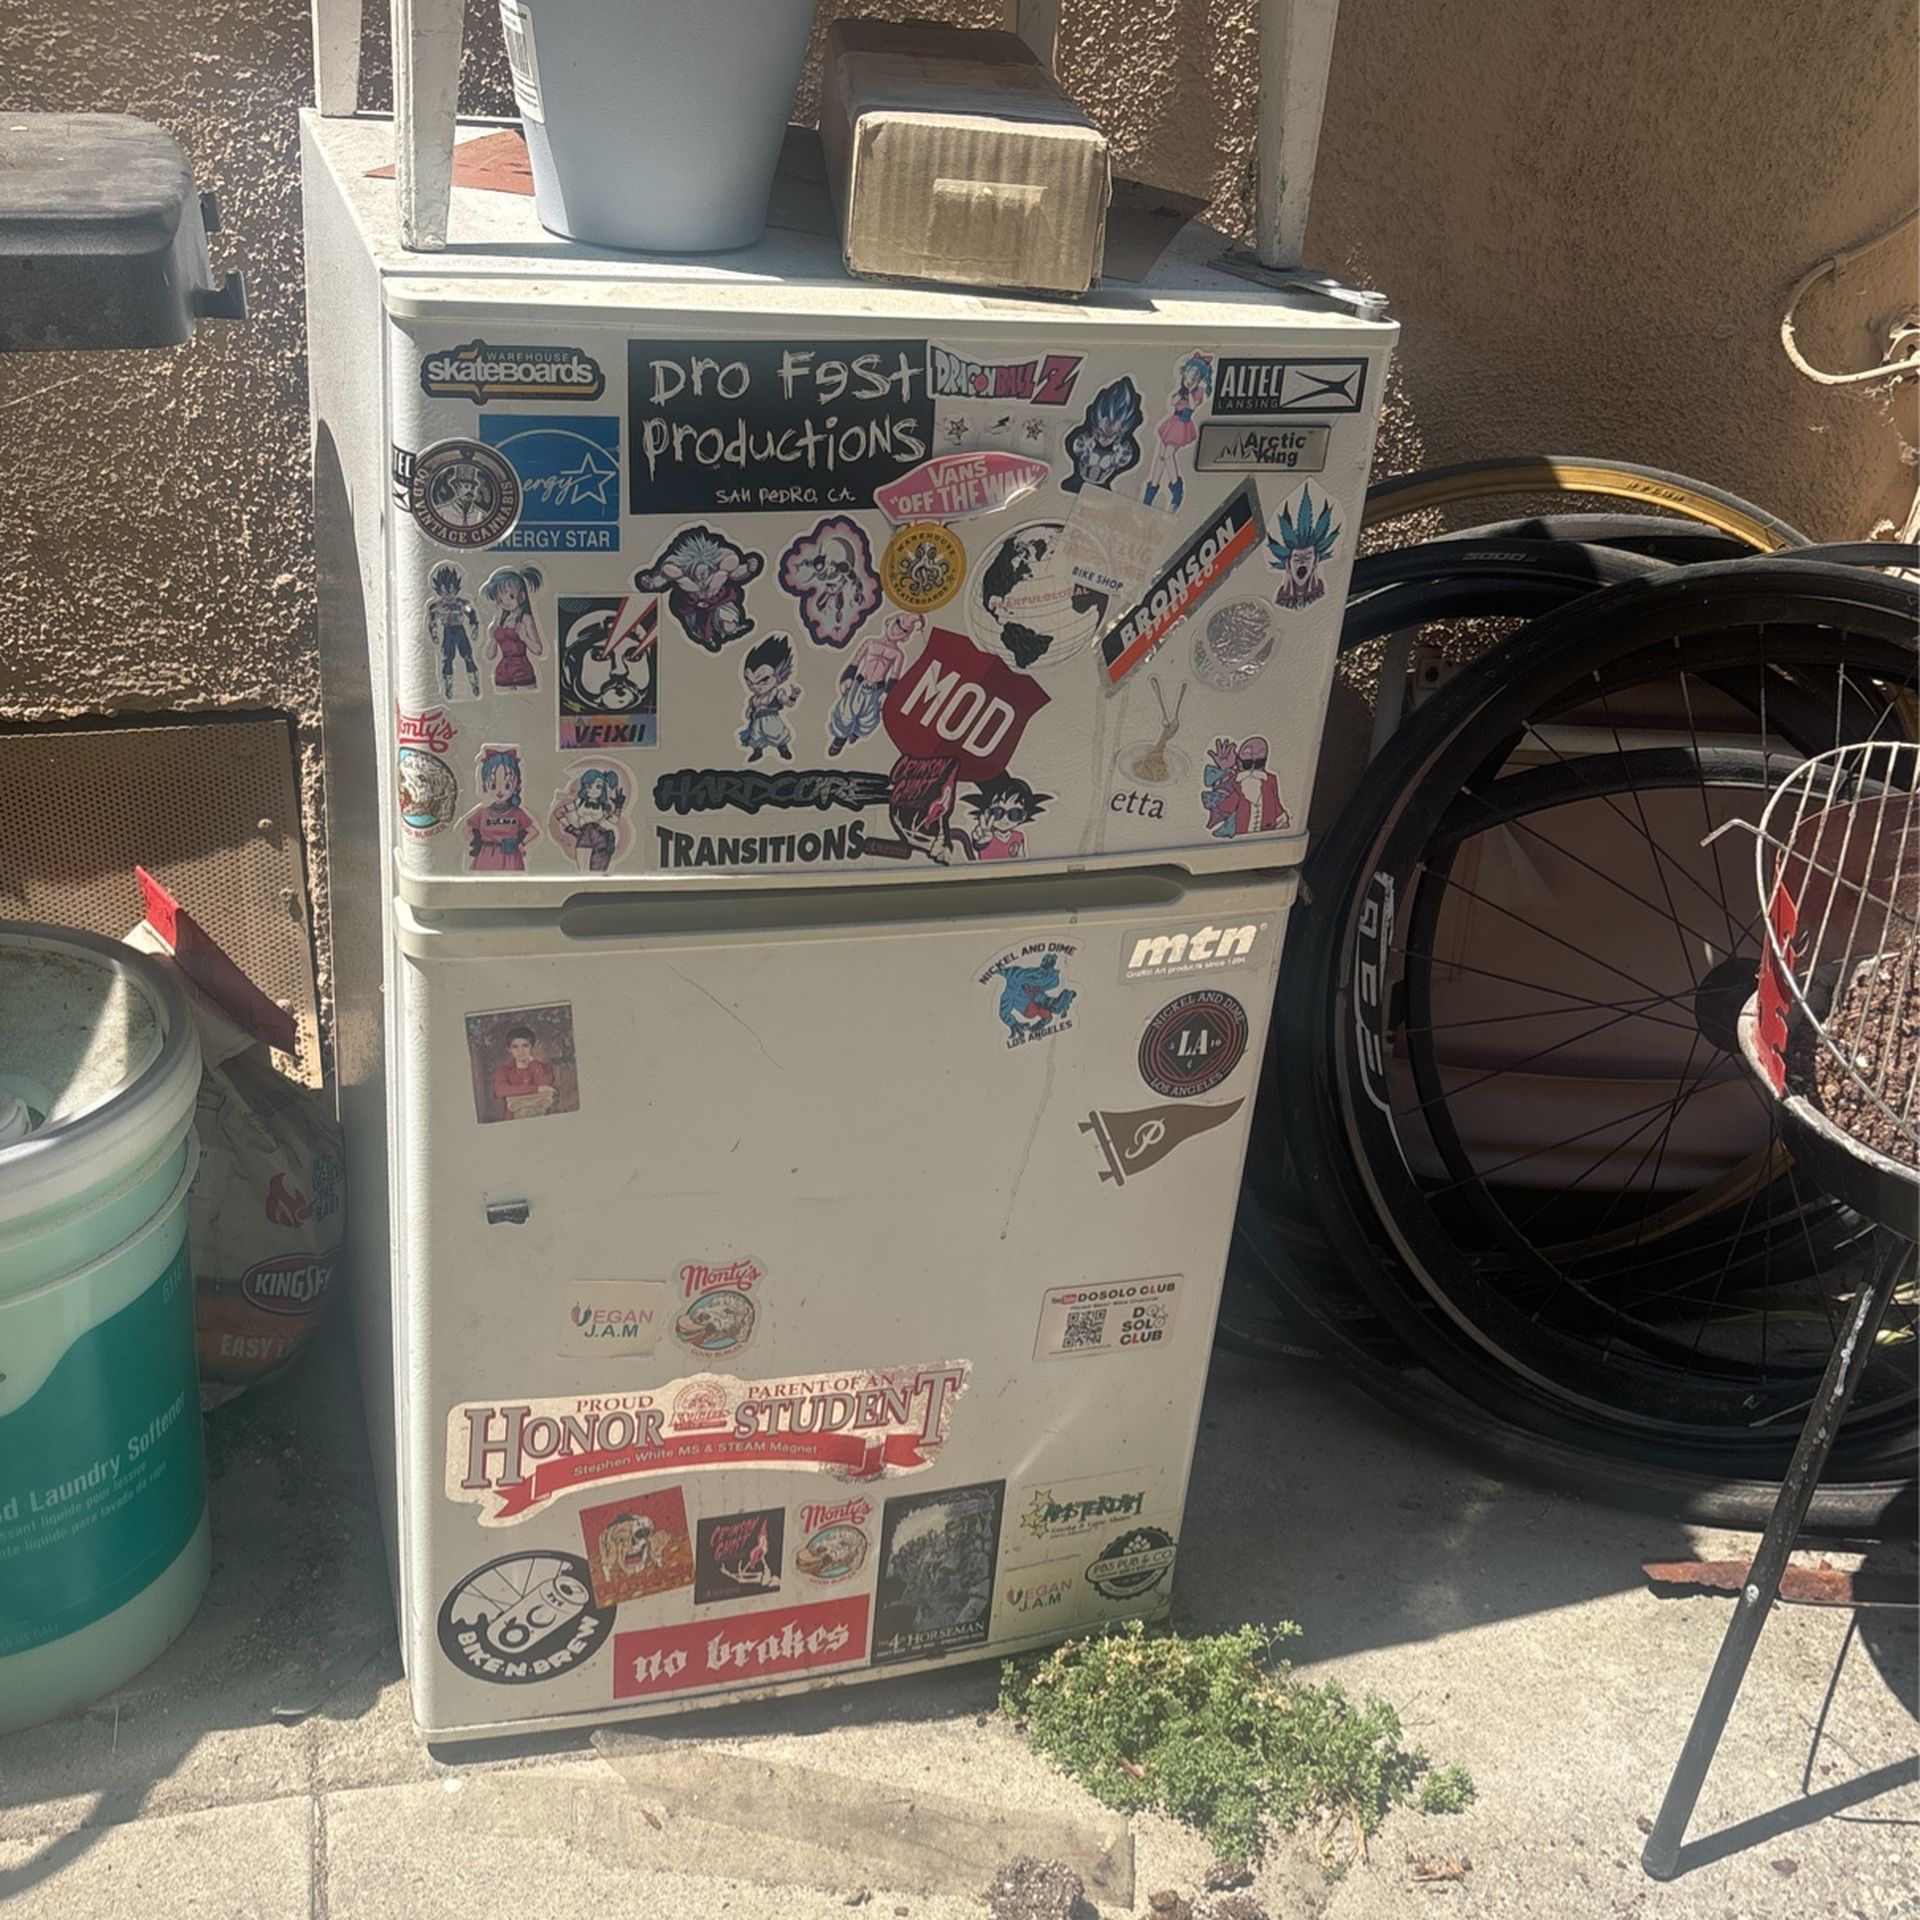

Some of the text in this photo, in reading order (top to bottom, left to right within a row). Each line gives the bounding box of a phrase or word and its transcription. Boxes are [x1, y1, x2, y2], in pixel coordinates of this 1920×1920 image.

[487, 352, 569, 361] WAREHOUSE
[1220, 365, 1284, 397] ALTEC
[1219, 400, 1279, 410] LANSING
[1244, 432, 1306, 449] Arctic
[927, 456, 988, 488] VANS
[1257, 447, 1298, 467] King
[937, 479, 979, 511] THE
[415, 500, 467, 543] VINTAGE
[471, 481, 514, 542] CANNABIS
[503, 530, 610, 548] NERGY STAR
[1072, 567, 1123, 591] BIKE SHOP
[1119, 515, 1238, 648] BRONSON
[900, 660, 1015, 757] MOD
[661, 775, 887, 807] HARDCORE
[1111, 791, 1163, 820] etta
[657, 820, 864, 868] TRANSITIONS
[1128, 924, 1258, 969] mtn
[979, 942, 1077, 985] NICKEL AND DIME
[1154, 966, 1167, 975] Art
[1152, 991, 1246, 1029] NICKEL AND DIME
[1006, 1020, 1073, 1050] LOS ANGELES
[1177, 1030, 1208, 1056] LA
[1151, 1072, 1224, 1096] LOS ANGELES
[680, 1260, 760, 1297] Monty's
[1078, 1287, 1137, 1302] DOSOLO
[1140, 1283, 1175, 1295] CLUB
[221, 1333, 273, 1359] EASY
[1120, 1330, 1163, 1346] CLUB
[575, 1396, 654, 1414] PROUD
[747, 1377, 829, 1399] PARENT
[832, 1373, 860, 1392] OF
[863, 1371, 896, 1388] AN
[461, 1368, 963, 1488] HONOR STUDENT
[30, 1455, 120, 1513] Laundry
[128, 1390, 186, 1461] Softener
[572, 1441, 818, 1478] Stephen White MS & STEAM Magnet
[86, 1488, 111, 1509] pour
[801, 1497, 873, 1533] Monty's
[907, 1620, 985, 1648] HORSEMAN
[633, 1650, 687, 1682] no
[706, 1620, 849, 1671] brakes
